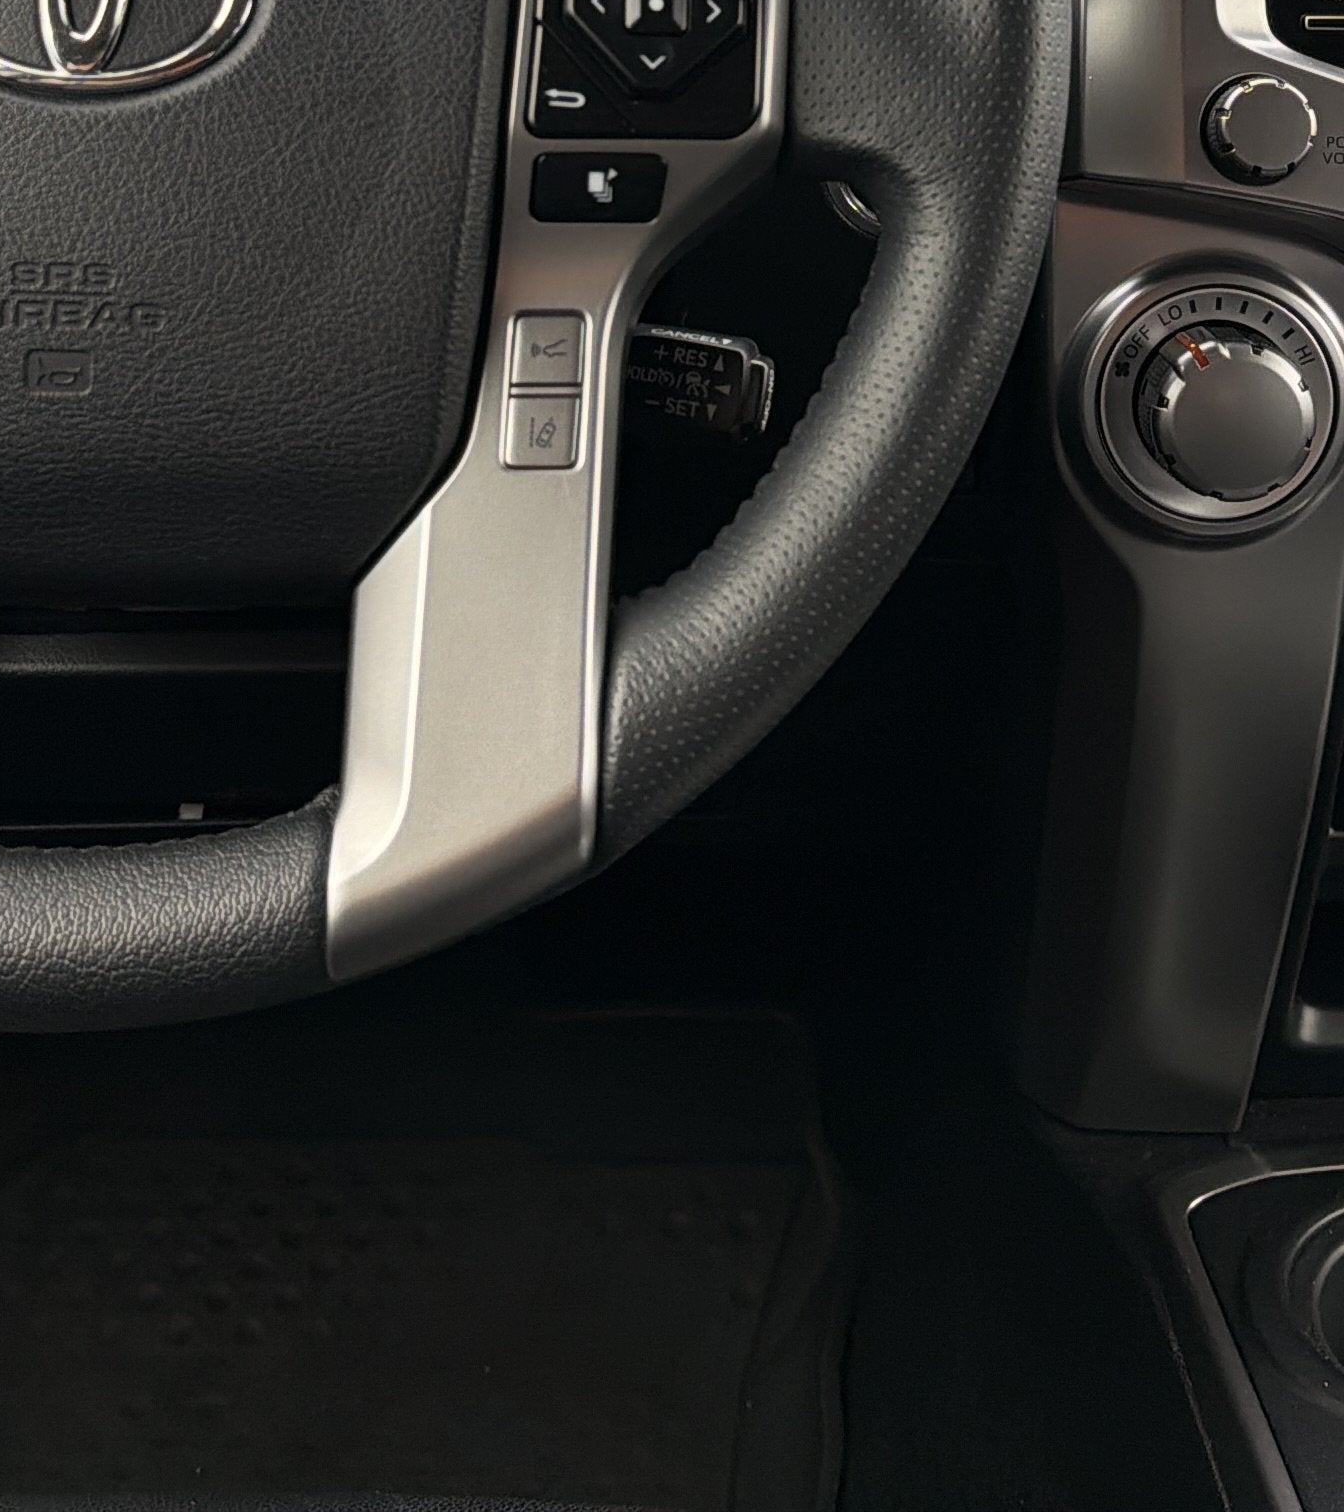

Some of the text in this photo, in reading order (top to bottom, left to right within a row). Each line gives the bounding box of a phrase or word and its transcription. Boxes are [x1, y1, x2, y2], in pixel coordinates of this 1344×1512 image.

[1157, 305, 1183, 327] LO
[651, 328, 720, 345] CANCEL
[1123, 324, 1151, 360] OFF
[1294, 345, 1316, 366] HI
